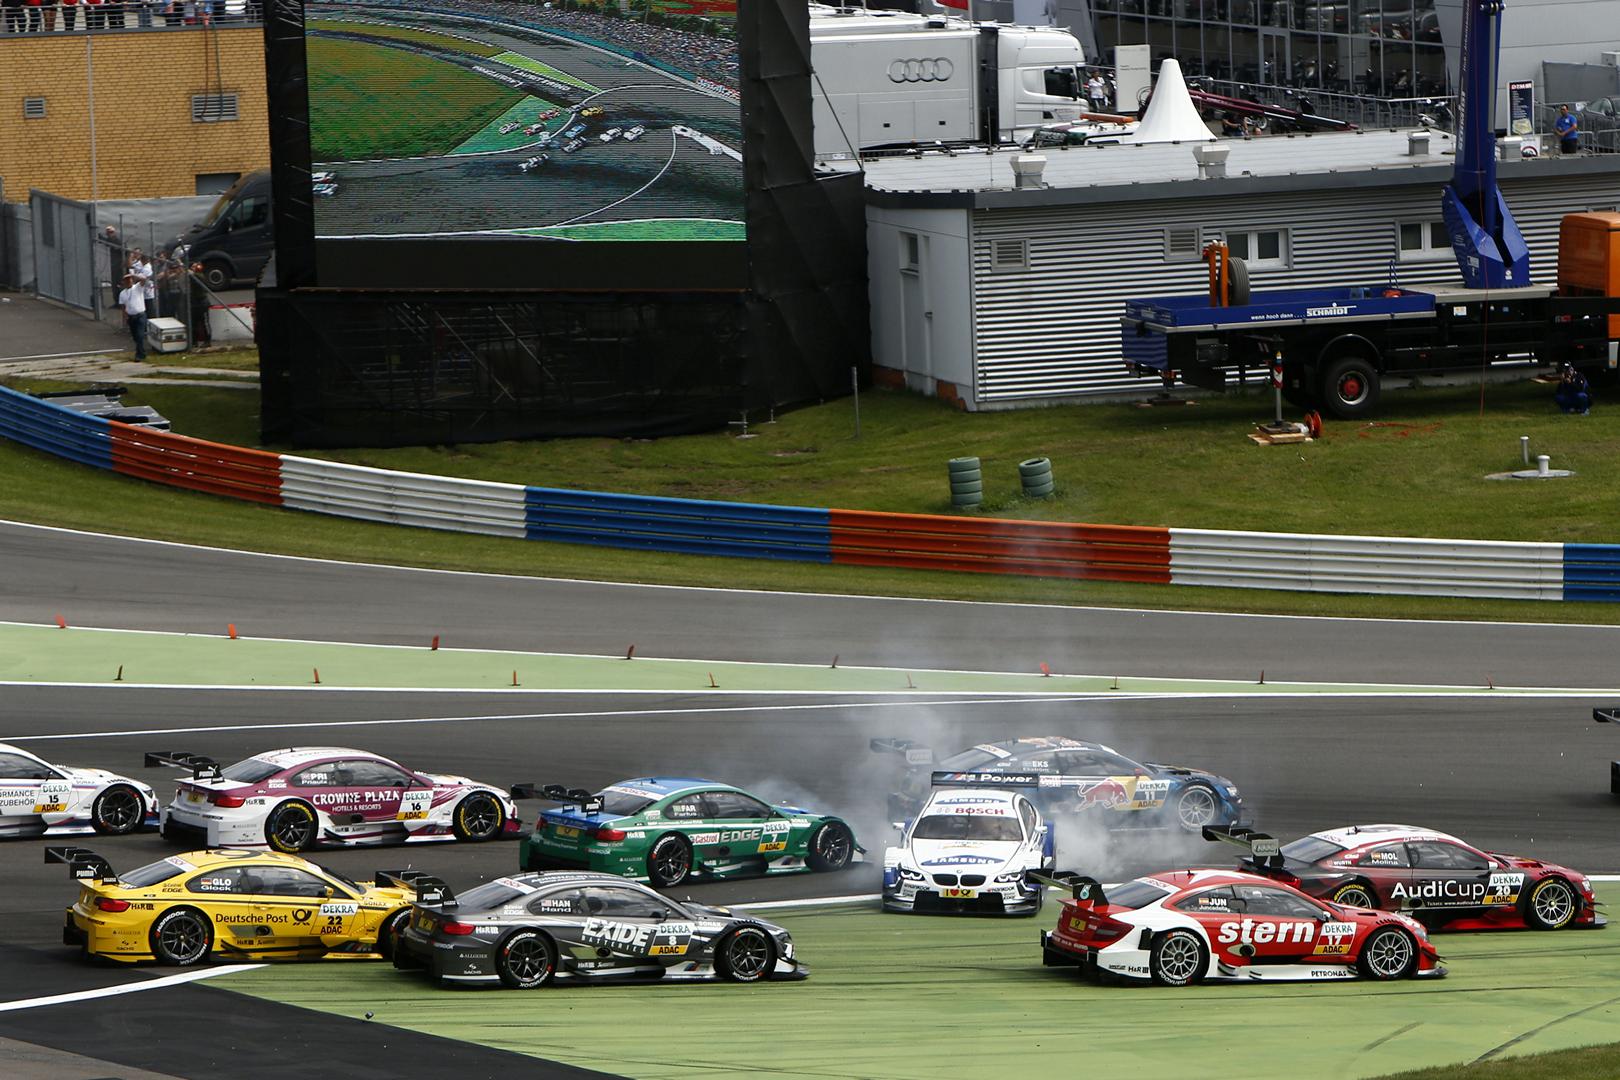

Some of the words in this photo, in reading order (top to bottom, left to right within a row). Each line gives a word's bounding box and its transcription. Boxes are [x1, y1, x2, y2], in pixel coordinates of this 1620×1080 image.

[1306, 305, 1350, 317] SCHMIDT
[1032, 760, 1049, 768] EKS
[980, 774, 1033, 784] Power
[42, 784, 70, 793] DEKRA
[49, 795, 59, 804] 15
[312, 791, 361, 805] CROWNE
[364, 790, 400, 803] PLAZA
[404, 792, 431, 801] DEKRA
[1145, 790, 1156, 800] 11
[41, 803, 60, 812] ADAC
[358, 803, 382, 811] RESORTS
[410, 802, 422, 811] 16
[681, 804, 697, 813] FAR
[1137, 800, 1158, 808] ADAC
[403, 811, 422, 820] ADAC
[954, 807, 1005, 815] BOSCH
[695, 833, 718, 843] Castrol
[719, 828, 761, 843] EDGE
[771, 833, 779, 843] 7
[764, 843, 780, 851] ADAC
[1380, 852, 1398, 861] MOL
[212, 878, 232, 886] GLO
[1493, 875, 1521, 885] DEKRA
[1390, 880, 1485, 900] AudiCup
[1495, 885, 1511, 896] 20
[1209, 898, 1227, 906] JUN
[1491, 895, 1511, 903] ADAC
[551, 900, 571, 908] HAN
[322, 904, 355, 915] DEKRA
[215, 913, 264, 923] Deutsche
[266, 913, 289, 923] Post
[327, 915, 343, 926] 22
[320, 925, 343, 935] ADAC
[582, 917, 652, 948] EXIDE
[660, 924, 690, 935] DEKRA
[1217, 918, 1315, 945] stern
[1324, 924, 1354, 934] DEKRA
[580, 934, 646, 955] BATTERIES
[668, 935, 678, 946] 8
[1326, 934, 1343, 946] 17
[658, 946, 680, 955] ADAC
[1322, 945, 1343, 954] ADAC
[1311, 969, 1347, 977] PETRONAS
